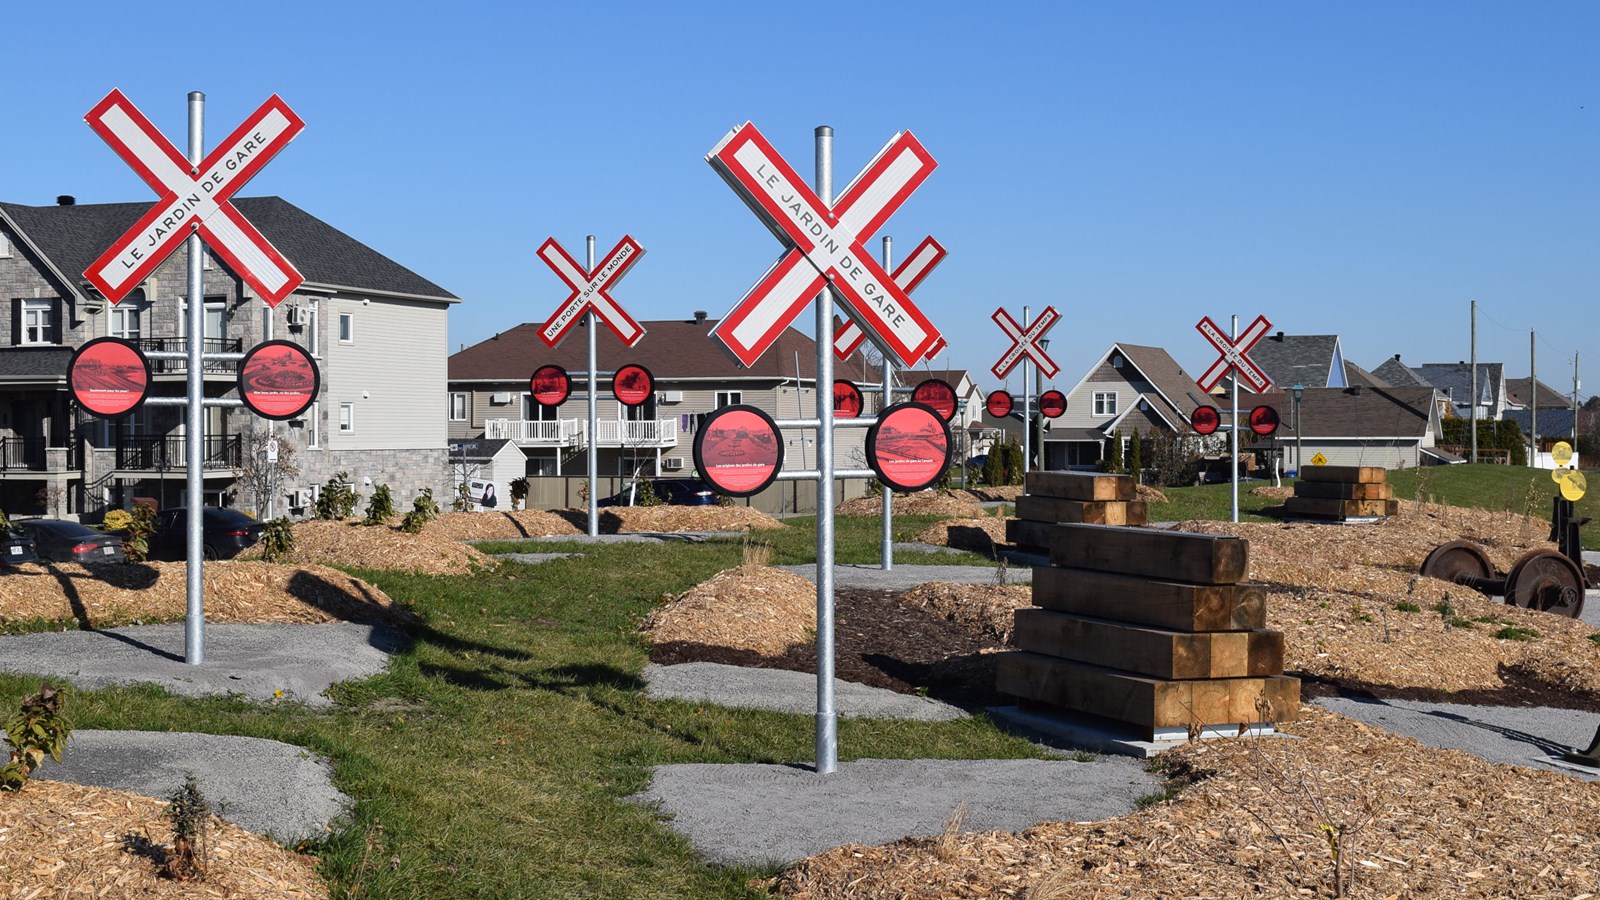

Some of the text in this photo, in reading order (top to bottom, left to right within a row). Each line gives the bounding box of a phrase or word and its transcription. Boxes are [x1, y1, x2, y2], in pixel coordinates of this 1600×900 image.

[121, 132, 266, 269] LE JARDIN DE GARE
[756, 164, 906, 329] LE JARDIN DE GARE
[546, 245, 632, 337] UNE PORTE SUR LE MONDE
[1002, 360, 1010, 369] LA
[1028, 331, 1036, 340] DU
[1035, 313, 1052, 331] TEMPS
[1207, 329, 1215, 337] LA
[1237, 359, 1246, 368] DU
[1246, 367, 1264, 386] TEMPS
